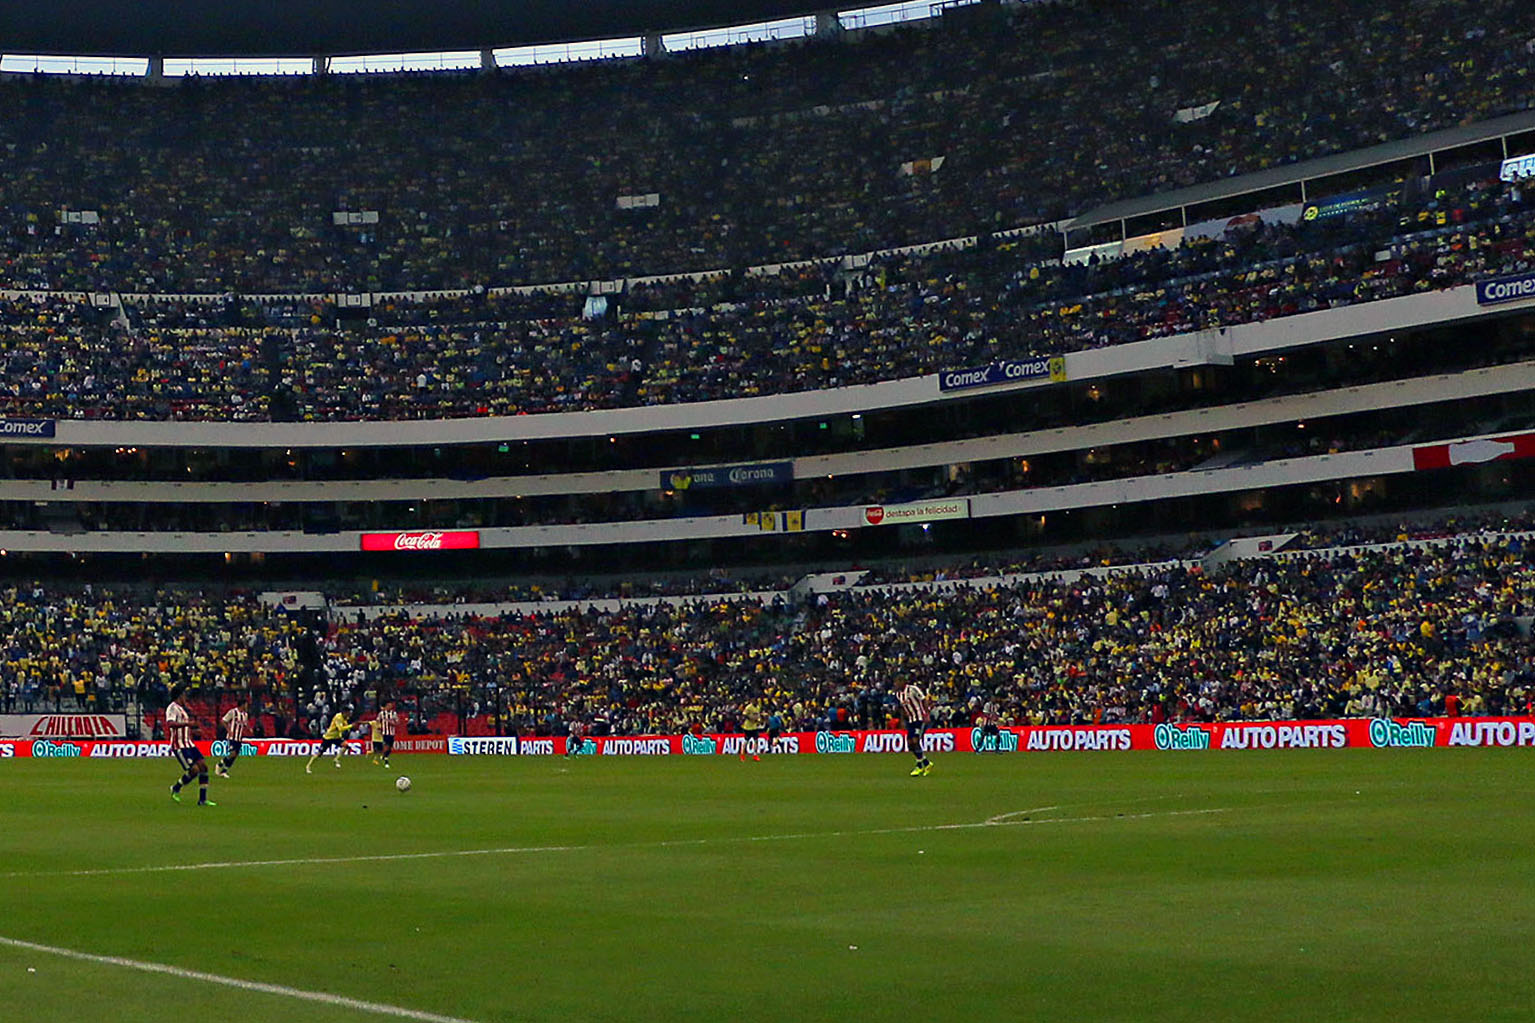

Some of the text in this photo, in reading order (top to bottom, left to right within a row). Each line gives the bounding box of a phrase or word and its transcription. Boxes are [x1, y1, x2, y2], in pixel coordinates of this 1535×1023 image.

[1484, 278, 1535, 299] Come
[945, 366, 991, 387] Comex
[1005, 359, 1050, 378] Comex
[729, 468, 774, 483] Corona
[885, 504, 958, 519] destapa la felicidad
[1027, 730, 1074, 751] AUTO
[1075, 729, 1132, 750] PARTS
[1154, 724, 1345, 750] O'Reilly AUTO PARTS
[1370, 718, 1436, 748] O'Reilly
[1449, 722, 1516, 746] AUTO
[32, 740, 81, 757] O'Reilly
[90, 744, 137, 757] AUTO
[267, 743, 312, 756] AUTO
[393, 740, 445, 750] OME DEPOT
[464, 740, 514, 754] STEREN
[521, 740, 554, 755] PARTS
[603, 740, 633, 754] AUTO
[634, 739, 670, 754] PARTS
[864, 733, 904, 752] AUTO
